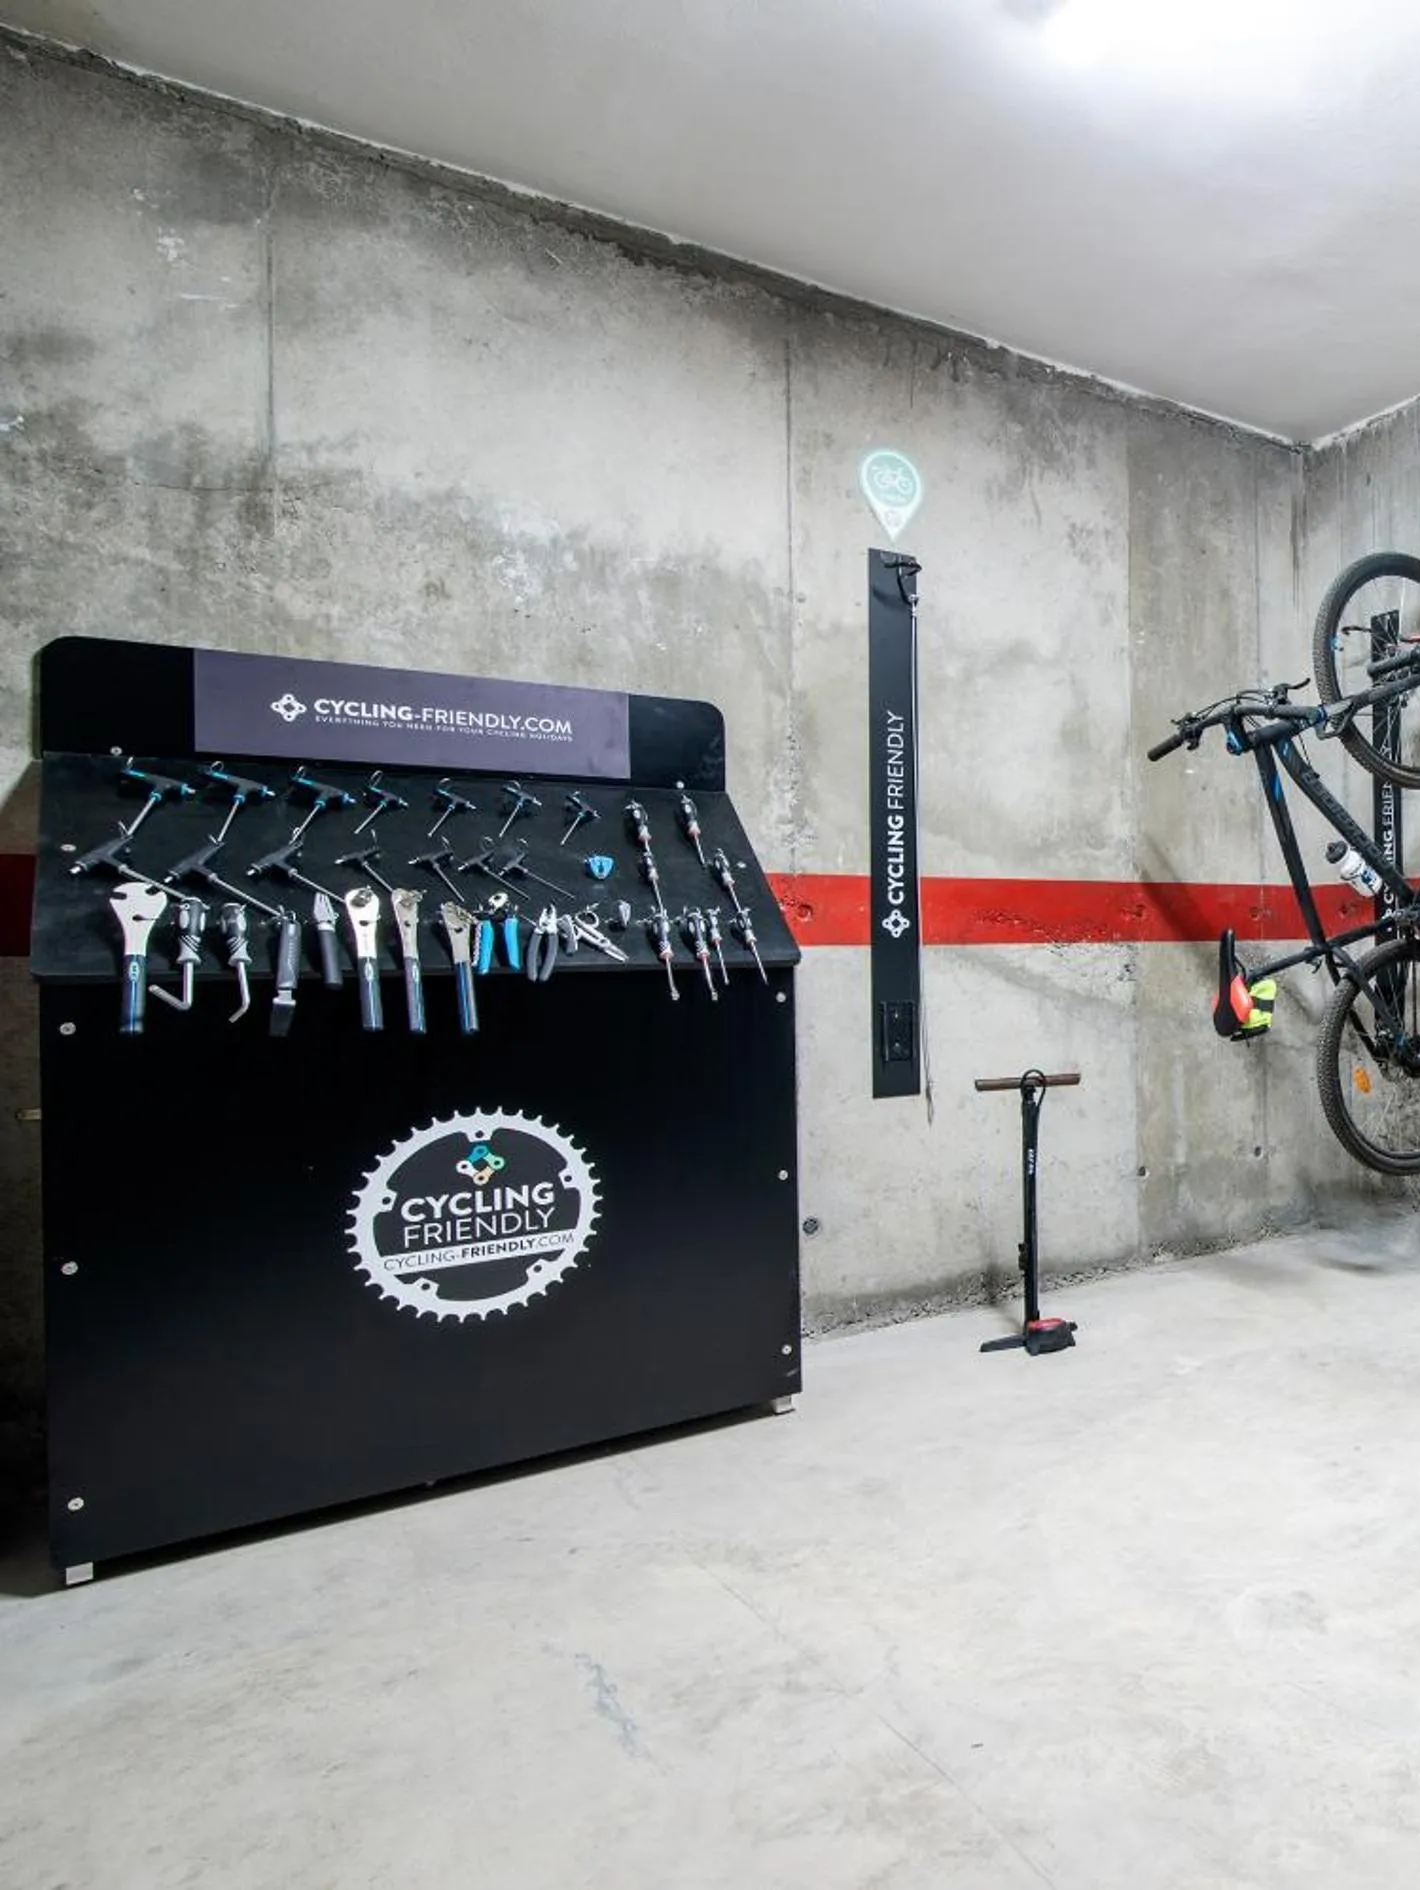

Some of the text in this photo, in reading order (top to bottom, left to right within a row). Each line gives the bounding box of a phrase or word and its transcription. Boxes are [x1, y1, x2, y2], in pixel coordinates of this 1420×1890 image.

[314, 698, 573, 734] CYCLING-FRIENDLY.COM
[886, 711, 905, 904] CYCLING FRIENDLY
[402, 1182, 555, 1222] CYCLING
[403, 1207, 556, 1249] FRIENDLY
[383, 1231, 575, 1272] CYCLING-FRIENDLY.COM
